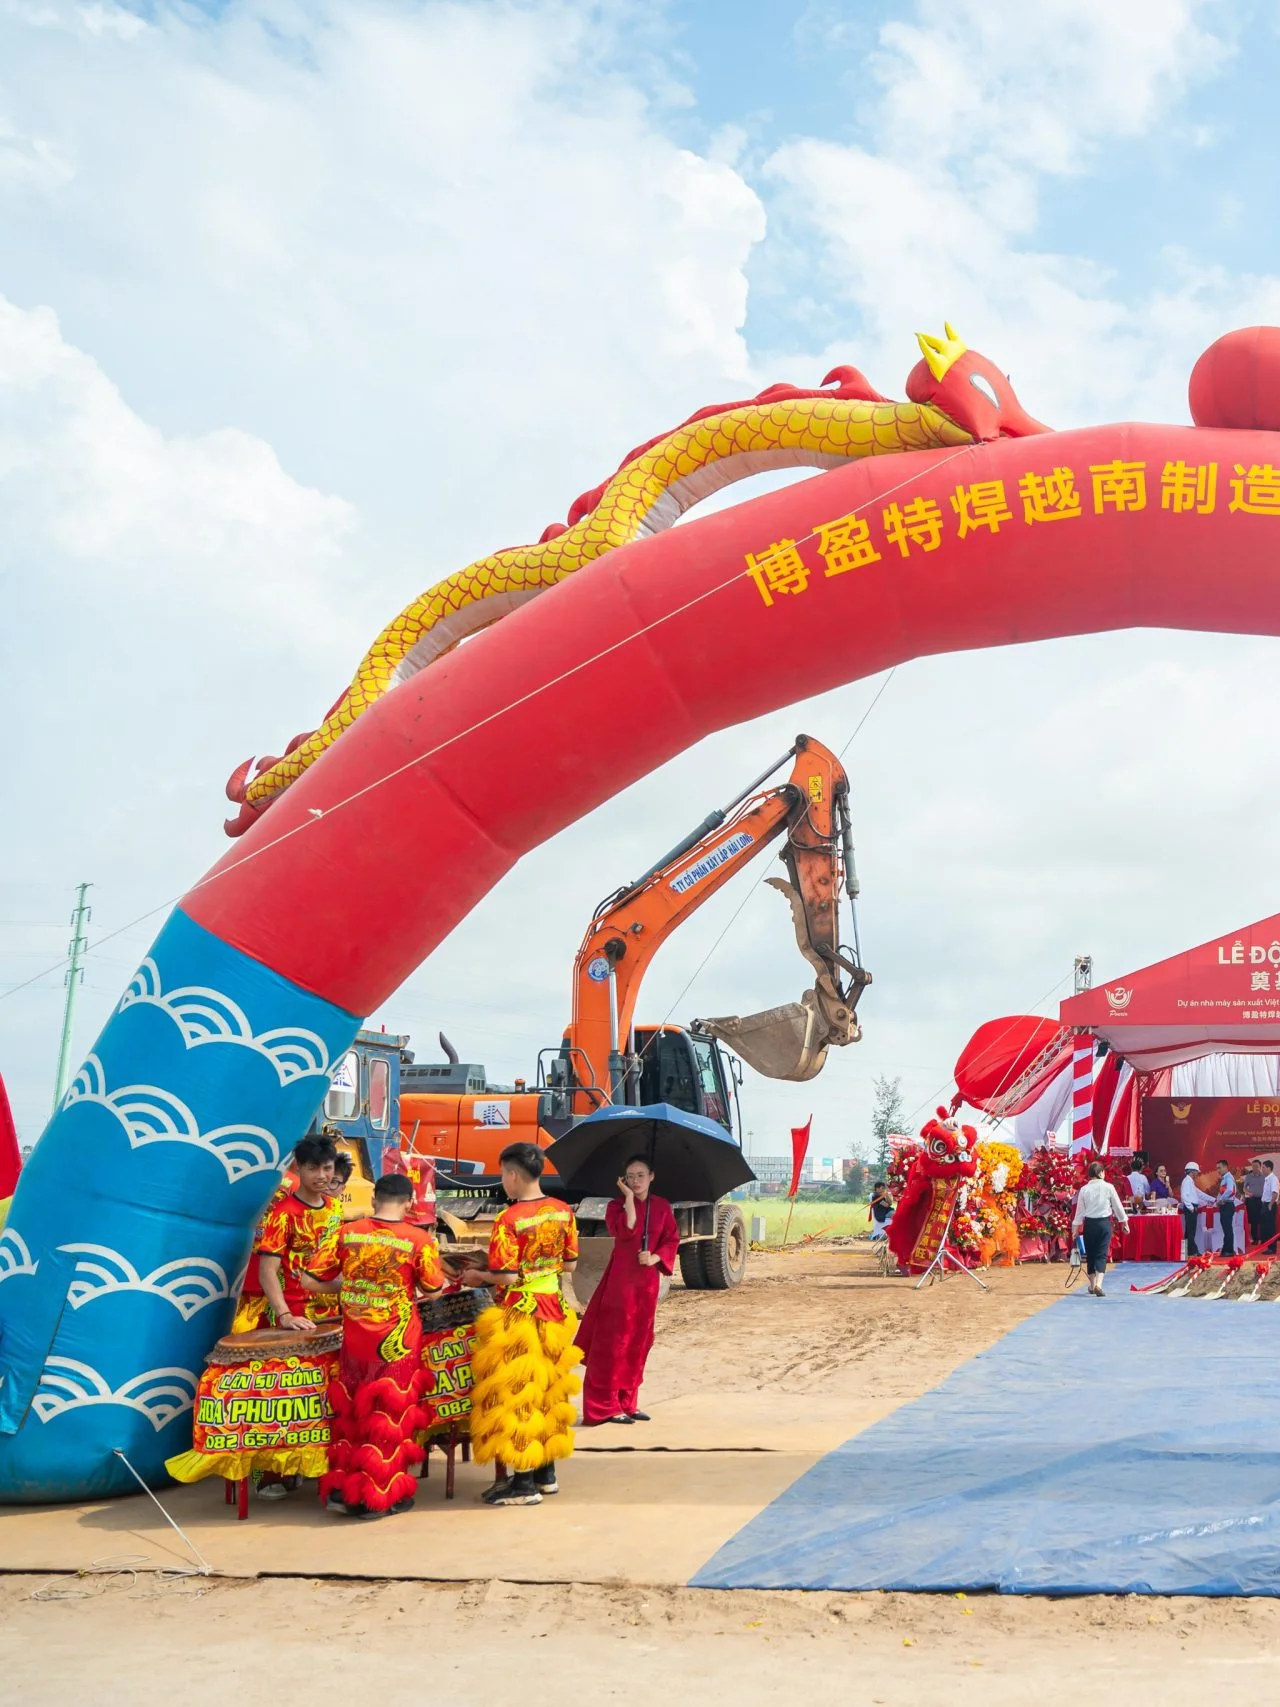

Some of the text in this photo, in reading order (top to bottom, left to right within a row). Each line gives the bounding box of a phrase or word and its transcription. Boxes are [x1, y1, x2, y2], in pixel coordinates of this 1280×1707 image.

[1218, 940, 1245, 964] LỄ
[1177, 1000, 1188, 1008] Dự
[1264, 998, 1280, 1007] Việt
[220, 1366, 322, 1390] LÂN SƯ RỒNG
[198, 1398, 224, 1425] HOA
[230, 1394, 322, 1427] PHƯỢNG
[438, 1398, 472, 1418] 082
[206, 1428, 331, 1450] 082 657 8888
